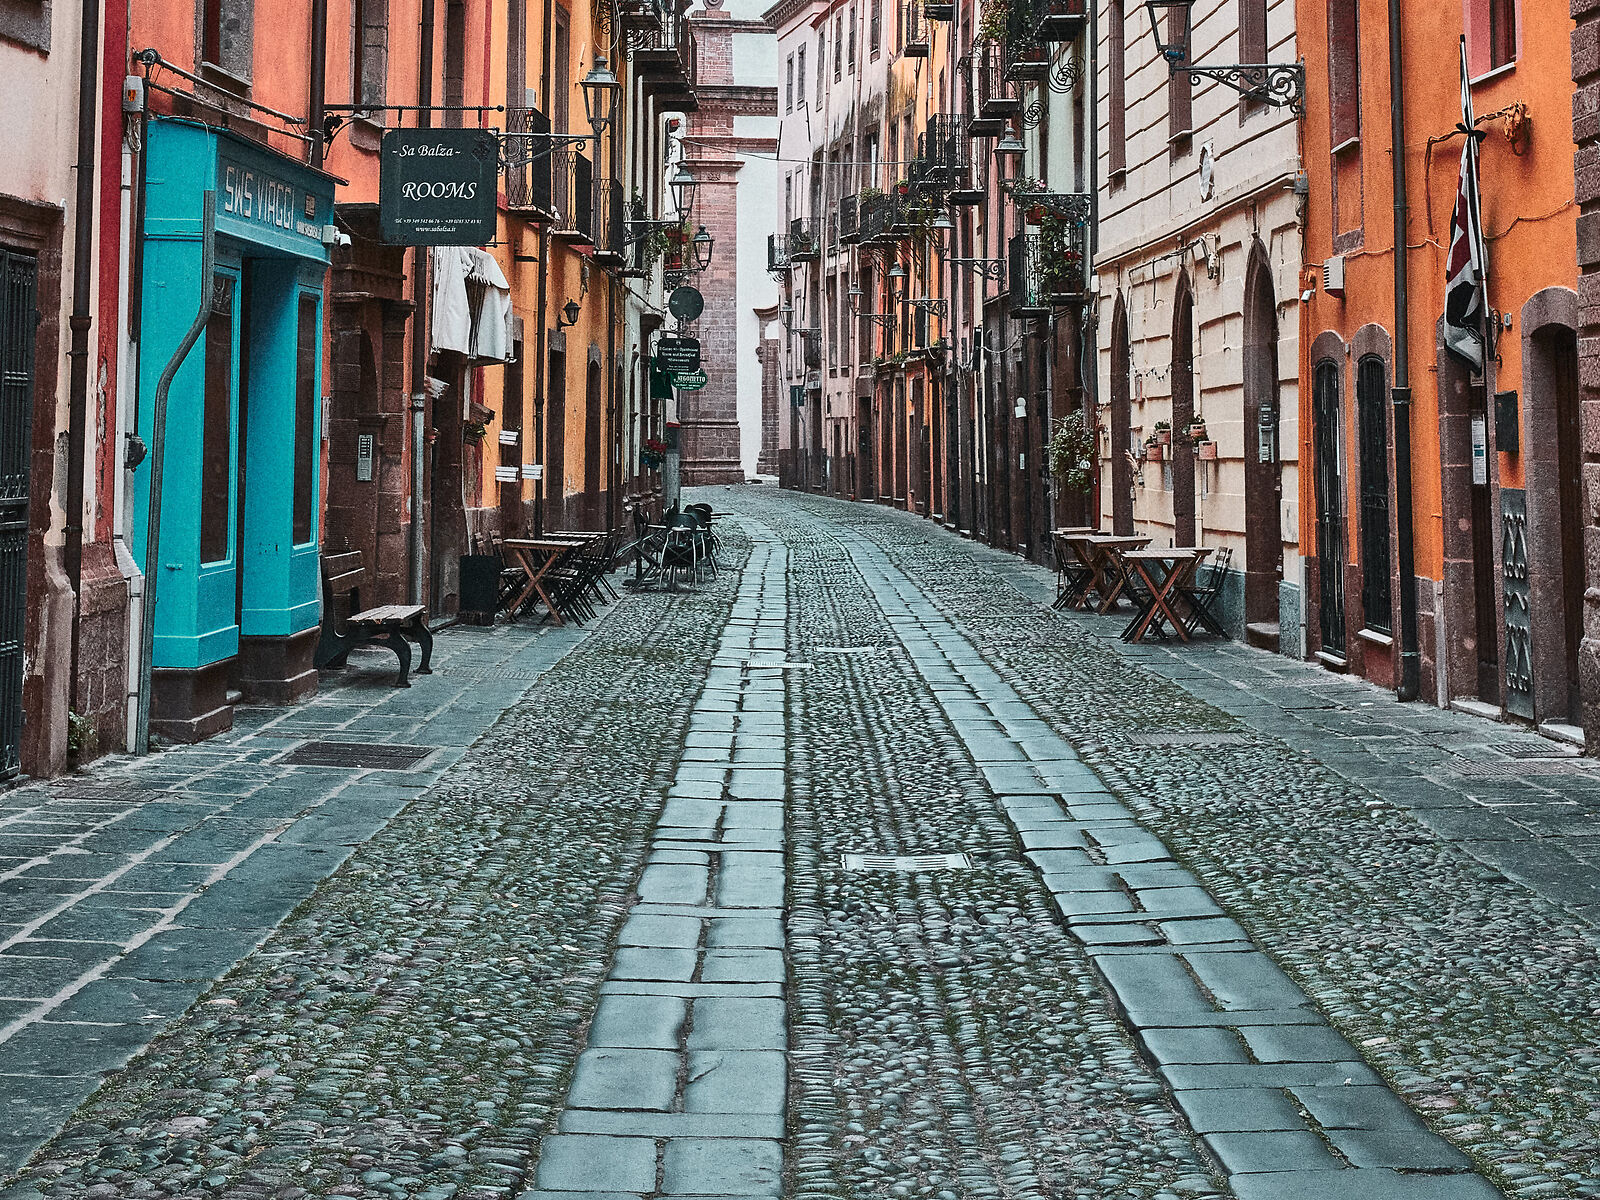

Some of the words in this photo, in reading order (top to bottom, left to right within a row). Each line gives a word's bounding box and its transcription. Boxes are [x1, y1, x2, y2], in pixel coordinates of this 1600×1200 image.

[224, 166, 254, 218] SWS
[257, 176, 295, 230] VIAGGI
[402, 181, 477, 201] ROOMS
